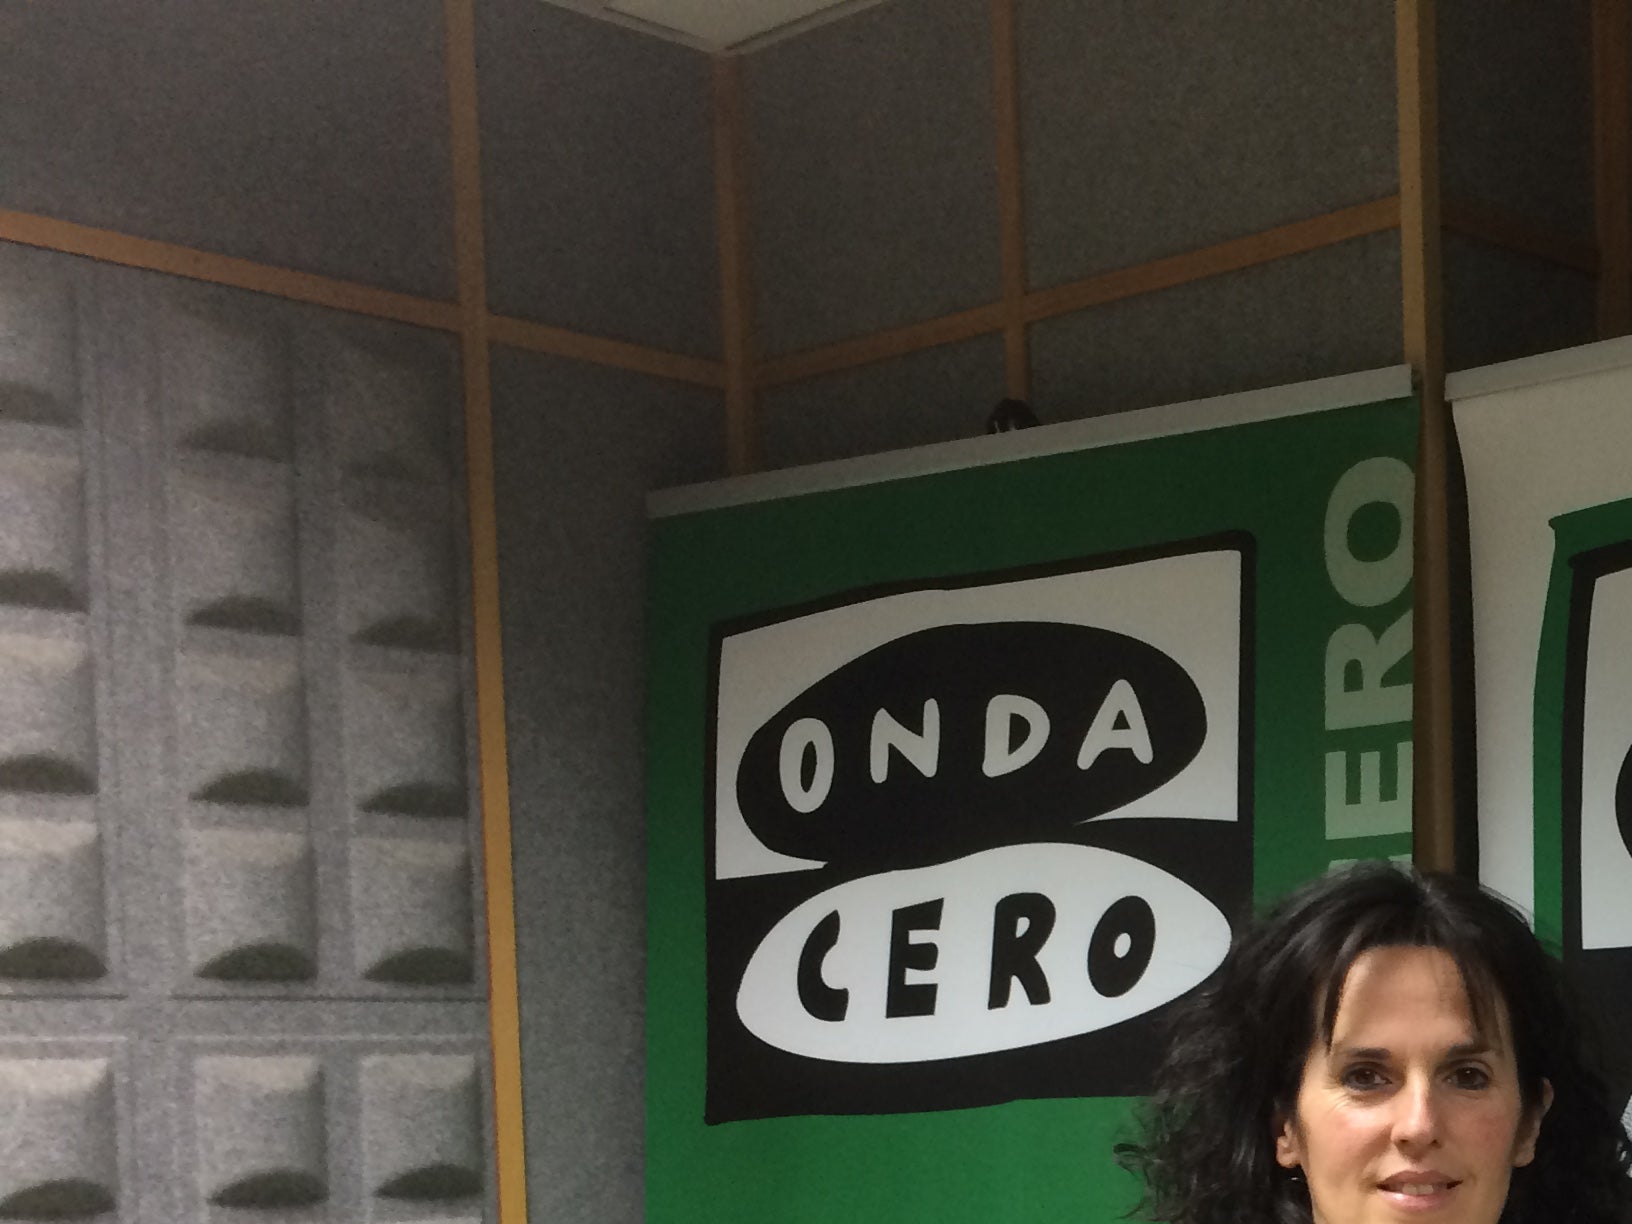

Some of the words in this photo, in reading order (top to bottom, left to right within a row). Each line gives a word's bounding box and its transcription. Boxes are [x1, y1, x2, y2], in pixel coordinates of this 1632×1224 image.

[1324, 457, 1415, 872] ERO
[779, 679, 1153, 813] ONDA
[797, 892, 1156, 1022] CERO
